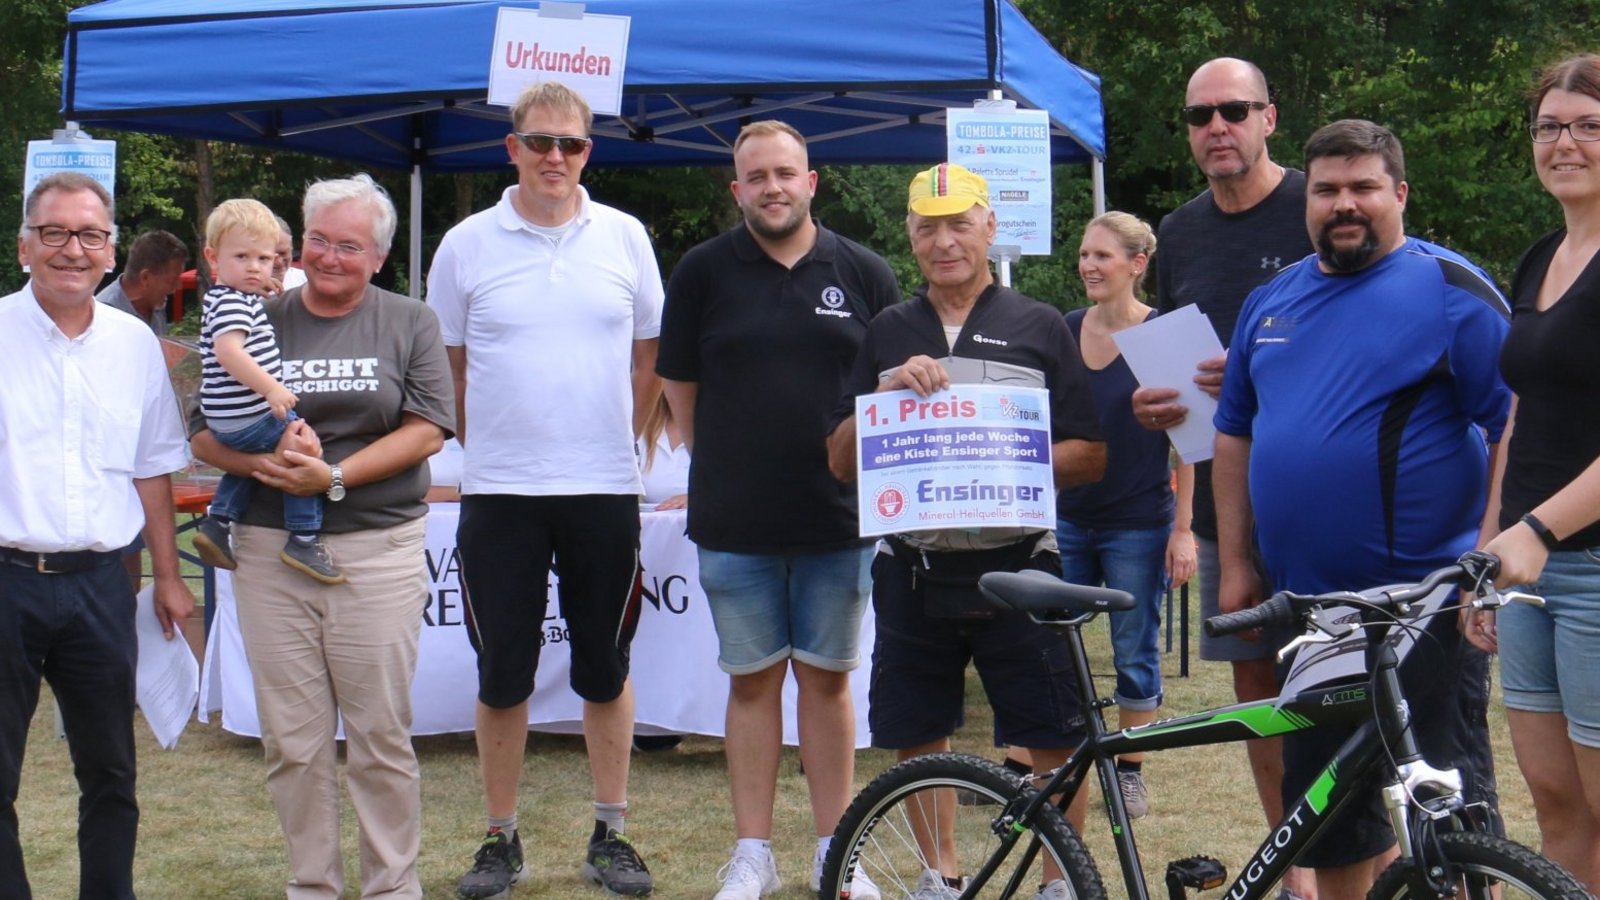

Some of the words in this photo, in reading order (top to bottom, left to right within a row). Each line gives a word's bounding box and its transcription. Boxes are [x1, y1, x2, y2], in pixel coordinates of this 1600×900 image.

[506, 41, 611, 76] Urkunden
[959, 124, 1046, 138] TOMBOLA-PREISE
[35, 154, 112, 167] TOMBOLA-PREISE
[995, 167, 1019, 177] Sprudel
[815, 307, 852, 318] Ensinger
[282, 358, 378, 380] ECHT
[864, 403, 889, 427] 1.
[899, 395, 976, 422] Preis
[1019, 410, 1040, 421] TOUR
[881, 439, 888, 449] 1
[892, 434, 920, 448] Jahr
[924, 434, 952, 446] lang
[955, 431, 985, 444] jede
[988, 431, 1031, 444] Woche
[875, 452, 901, 464] eine
[904, 449, 938, 460] Kiste
[942, 447, 1000, 459] Ensinger
[1004, 446, 1038, 459] Sport
[916, 479, 1044, 506] Ensinger
[918, 510, 1013, 521] Mineral-Heilquellen
[1016, 509, 1046, 519] GmbH
[1224, 806, 1305, 900] UGEOT
